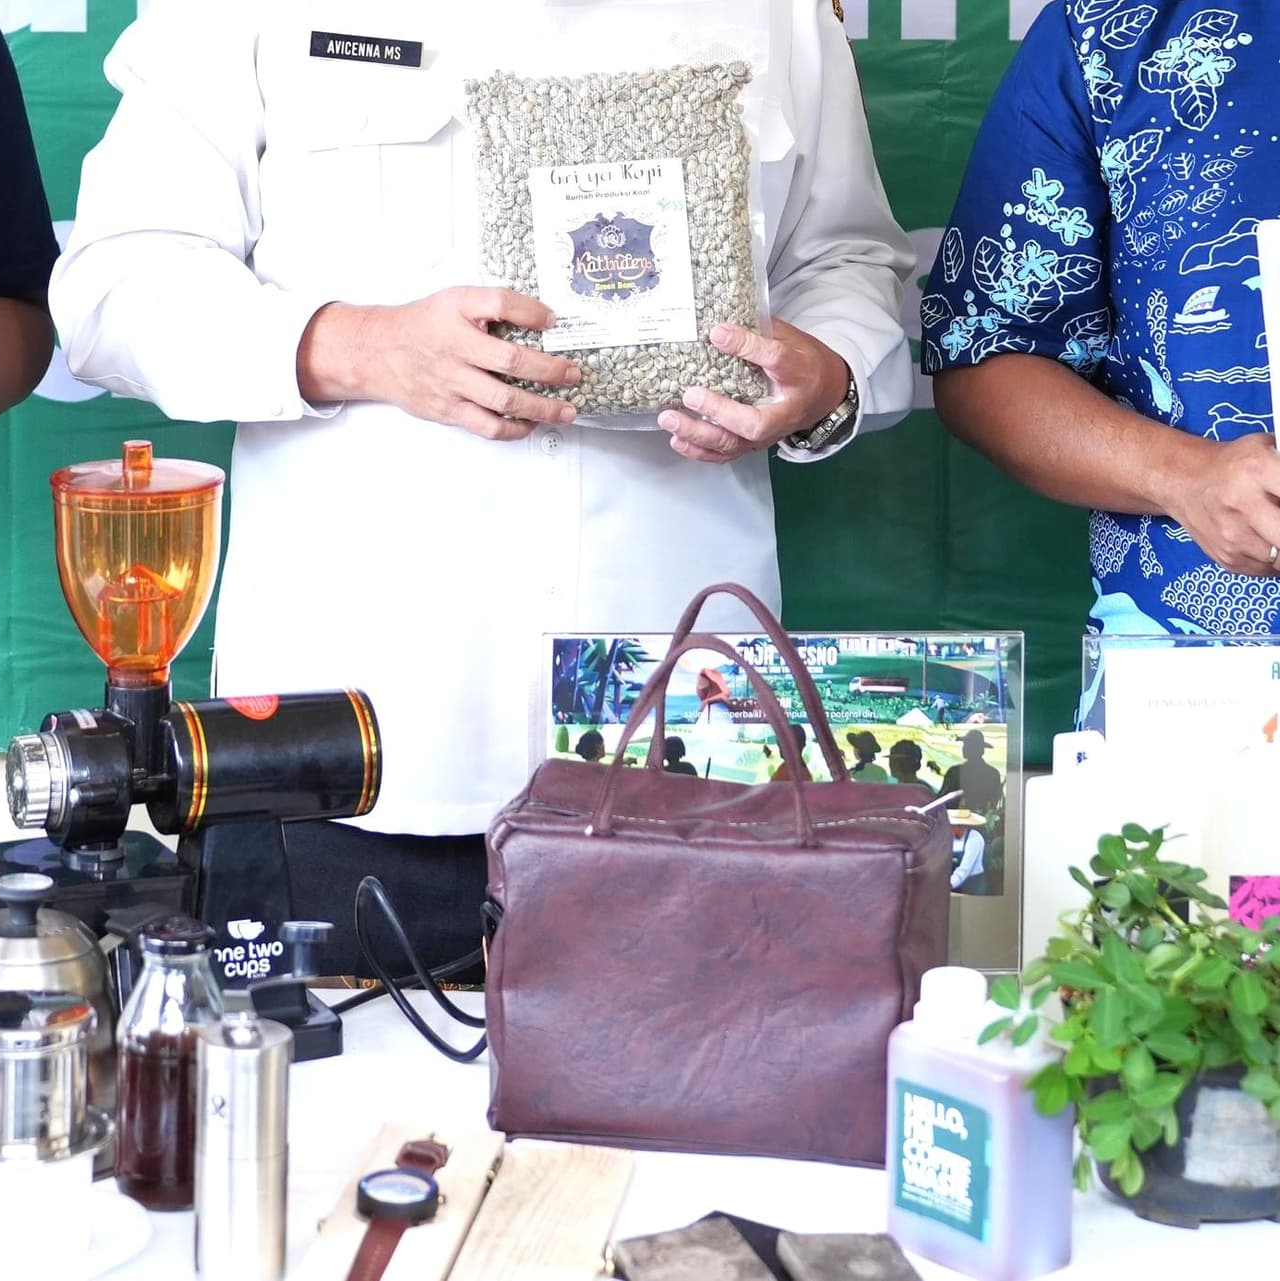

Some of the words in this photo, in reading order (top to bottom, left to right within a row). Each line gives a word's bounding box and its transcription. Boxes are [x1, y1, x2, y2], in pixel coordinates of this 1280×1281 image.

[326, 39, 381, 59] AVICENNA
[383, 45, 402, 61] MS
[248, 941, 284, 960] two
[223, 957, 272, 979] cups
